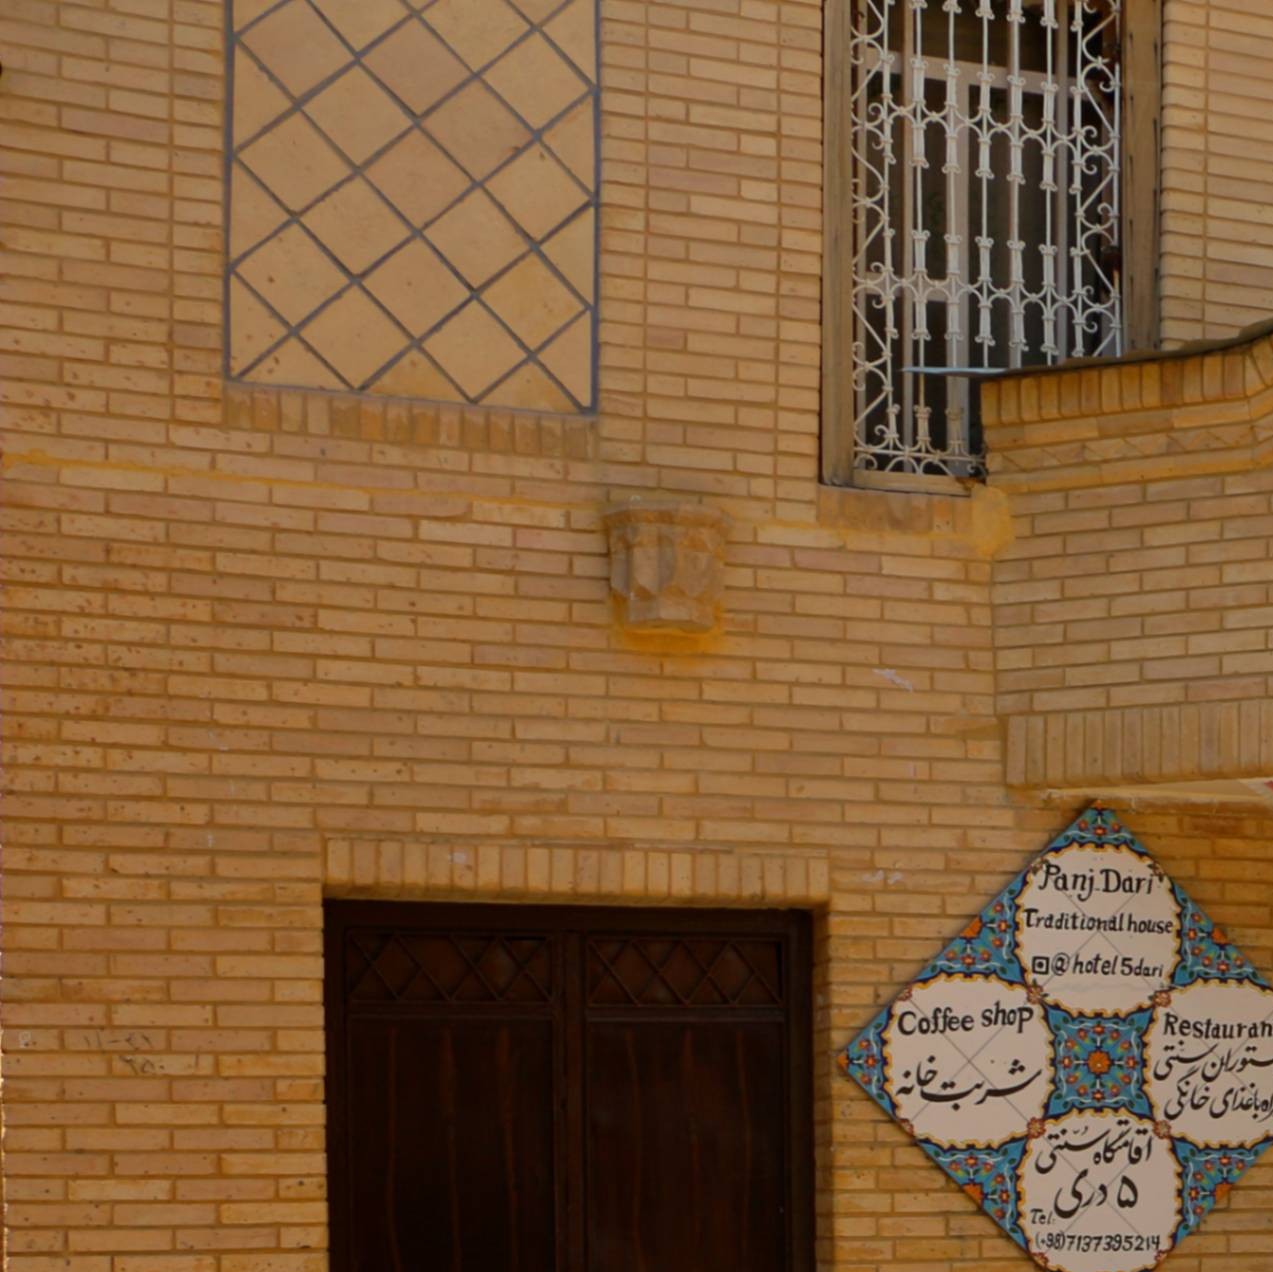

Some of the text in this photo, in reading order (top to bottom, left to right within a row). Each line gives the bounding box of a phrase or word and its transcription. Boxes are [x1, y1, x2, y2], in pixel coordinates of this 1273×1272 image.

[1038, 863, 1153, 902] Panj Dari
[1024, 908, 1174, 935] Traditional house
[897, 1000, 1034, 1036] Coffee shop
[1153, 1039, 1218, 1081] سنتی
[1092, 1119, 1152, 1165] اقامتگاه
[1053, 1168, 1138, 1219] ۵ دری
